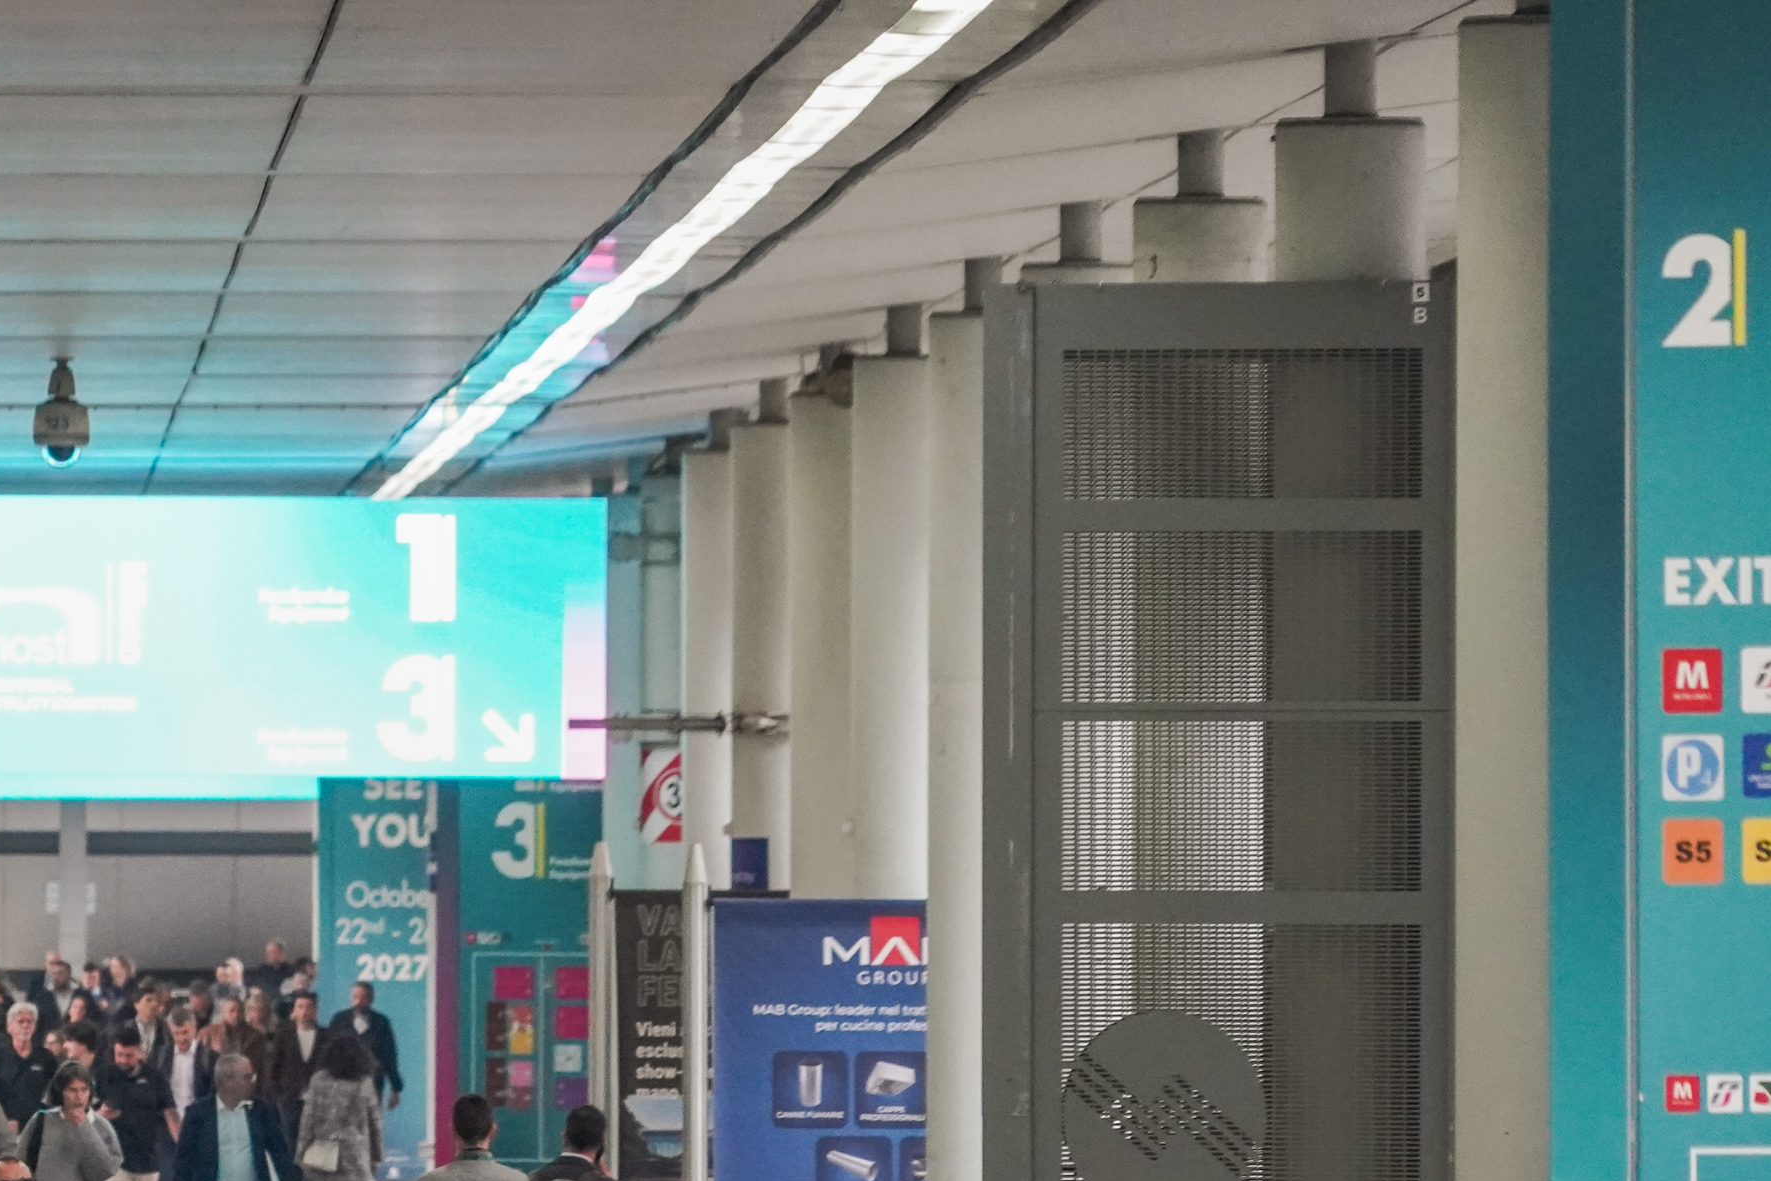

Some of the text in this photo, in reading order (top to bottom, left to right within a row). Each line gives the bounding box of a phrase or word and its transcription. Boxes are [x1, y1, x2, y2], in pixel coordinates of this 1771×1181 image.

[1662, 233, 1732, 347] 2
[396, 513, 440, 622] 1
[377, 654, 440, 762] 3
[350, 813, 431, 848] YOU
[492, 802, 534, 878] 3
[1675, 840, 1712, 863] S5
[345, 877, 428, 908] Octobe
[356, 953, 429, 981] 2027
[752, 1004, 786, 1015] MAB
[834, 1003, 876, 1016] leader
[878, 1003, 900, 1016] nel
[635, 1021, 677, 1038] Vieni
[814, 1020, 839, 1033] per
[839, 1018, 885, 1032] cucine
